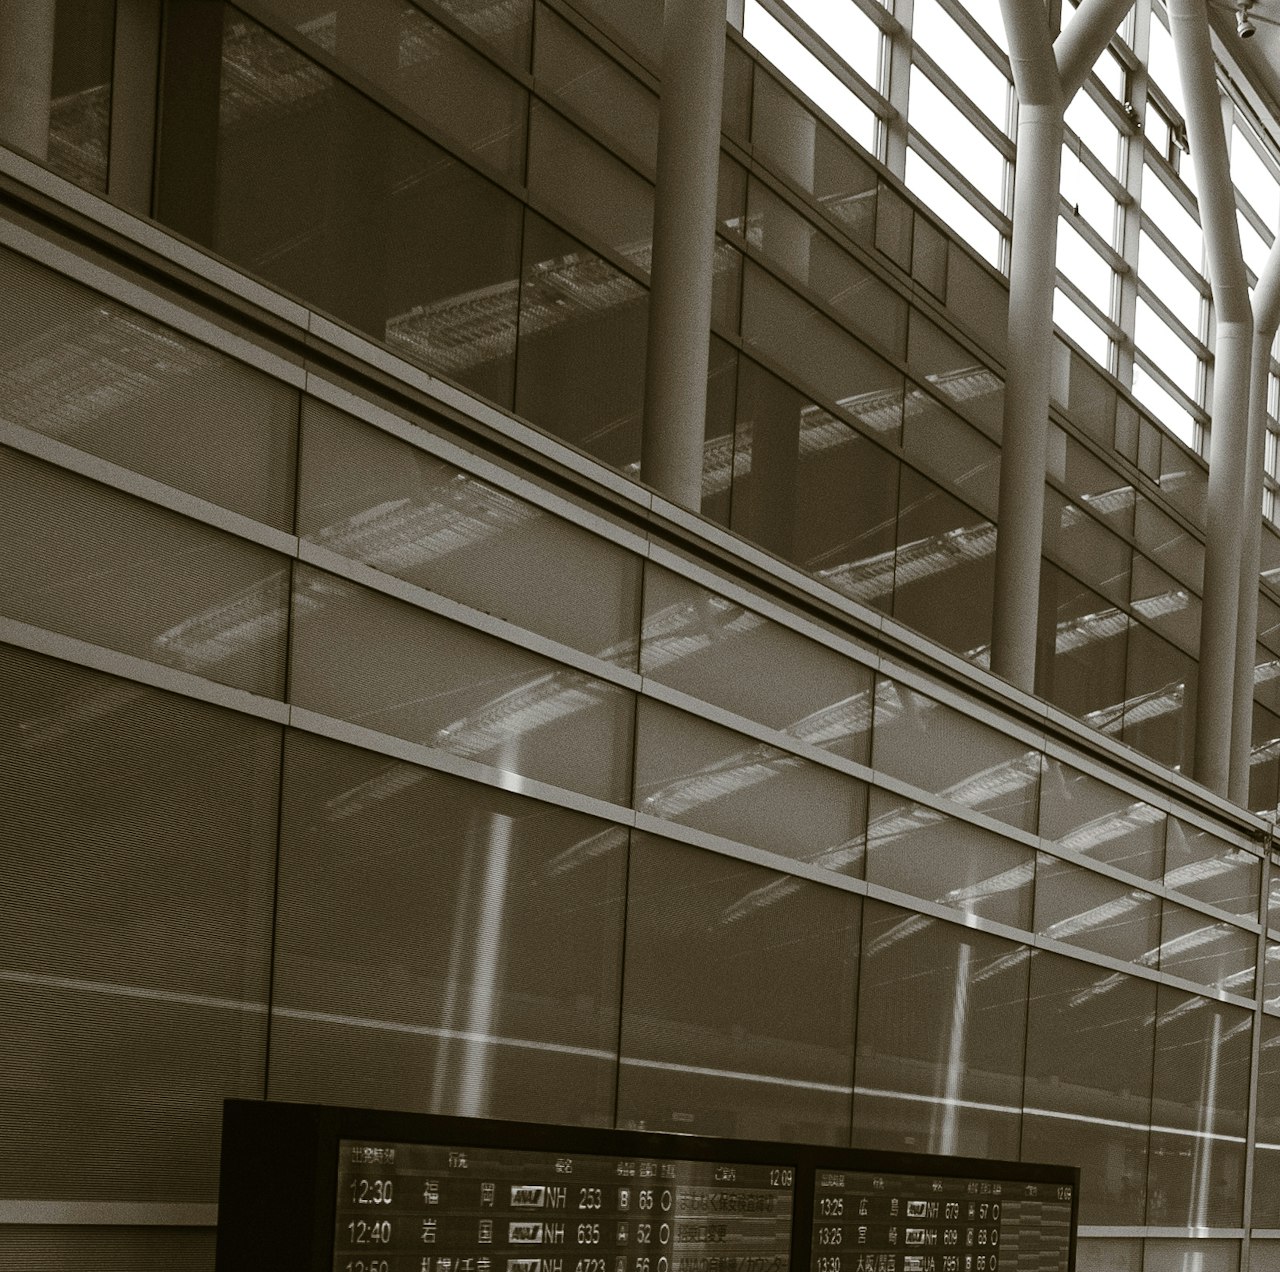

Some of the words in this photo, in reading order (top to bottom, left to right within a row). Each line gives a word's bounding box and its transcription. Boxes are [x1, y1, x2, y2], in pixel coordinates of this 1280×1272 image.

[348, 1178, 393, 1204] 12:30
[545, 1185, 567, 1208] NH
[578, 1188, 602, 1209] 253
[638, 1190, 654, 1210] 65
[819, 1198, 844, 1216] 13:25
[346, 1219, 391, 1244] 12:40
[543, 1221, 565, 1244] NH
[576, 1223, 600, 1244] 635
[636, 1224, 652, 1243] 52
[817, 1228, 842, 1245] 13:25
